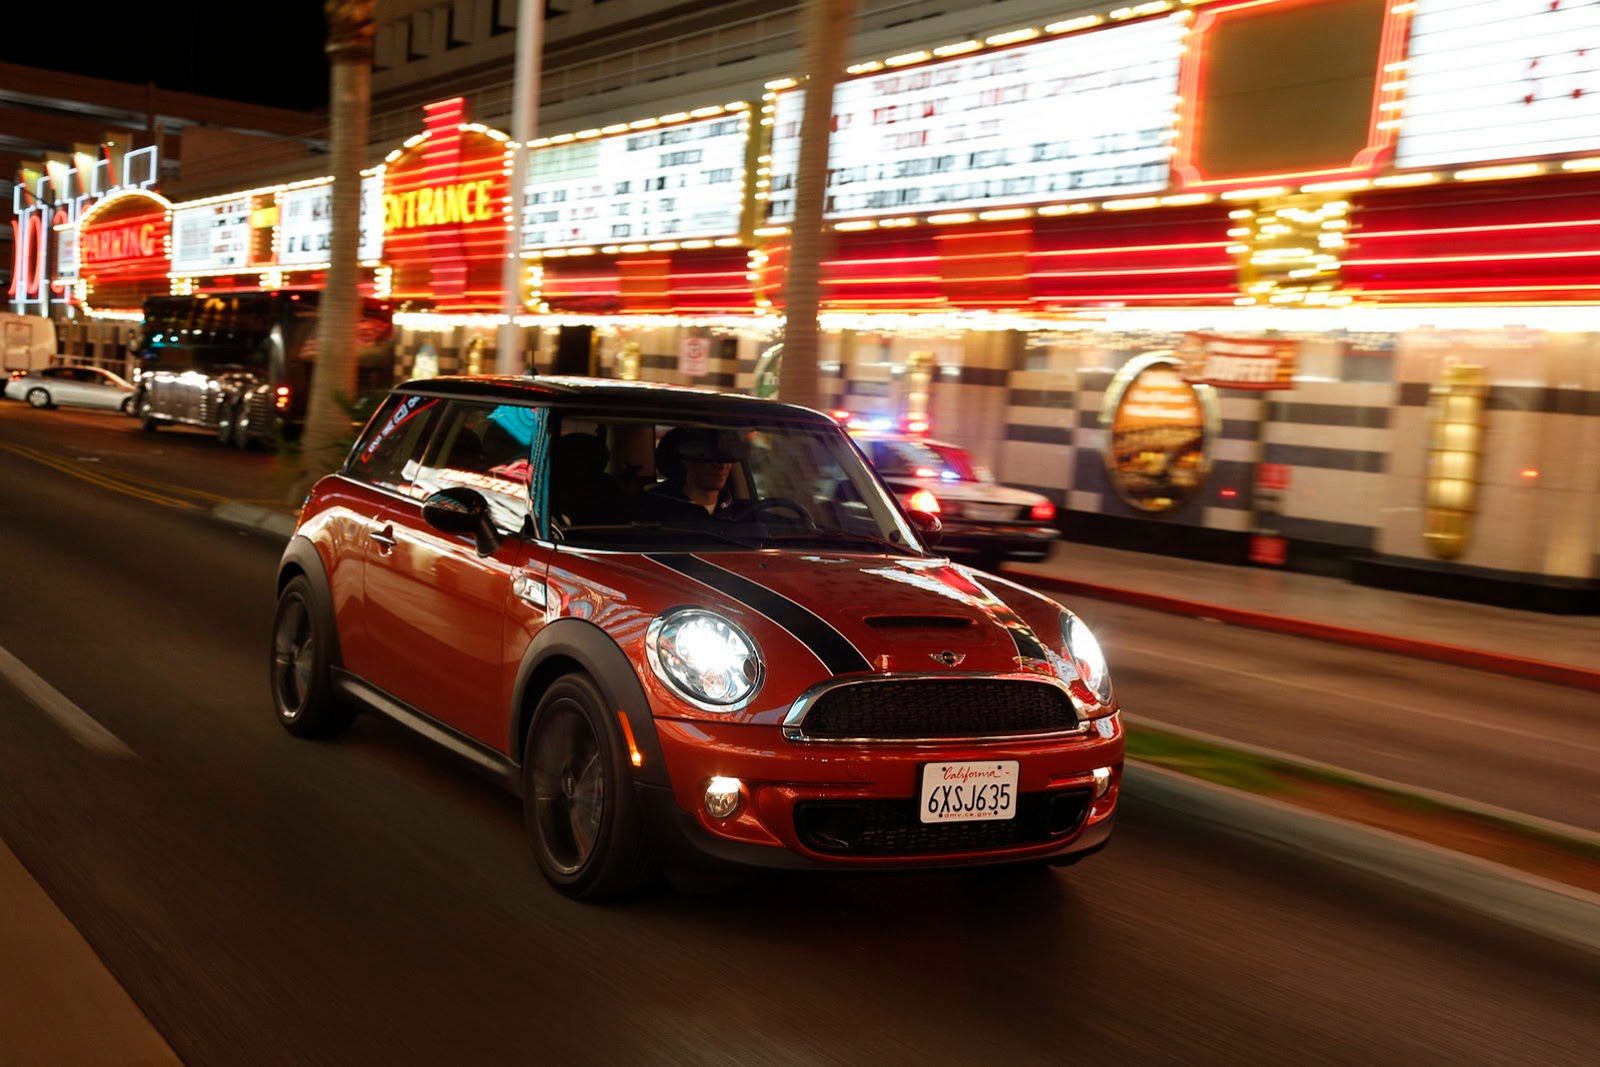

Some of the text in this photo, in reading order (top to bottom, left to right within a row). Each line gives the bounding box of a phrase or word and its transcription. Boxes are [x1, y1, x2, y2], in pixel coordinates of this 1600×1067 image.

[383, 180, 494, 232] ENTRANCE
[85, 223, 155, 263] PARKING
[943, 766, 1001, 783] California
[928, 784, 1010, 813] 6XSJ635
